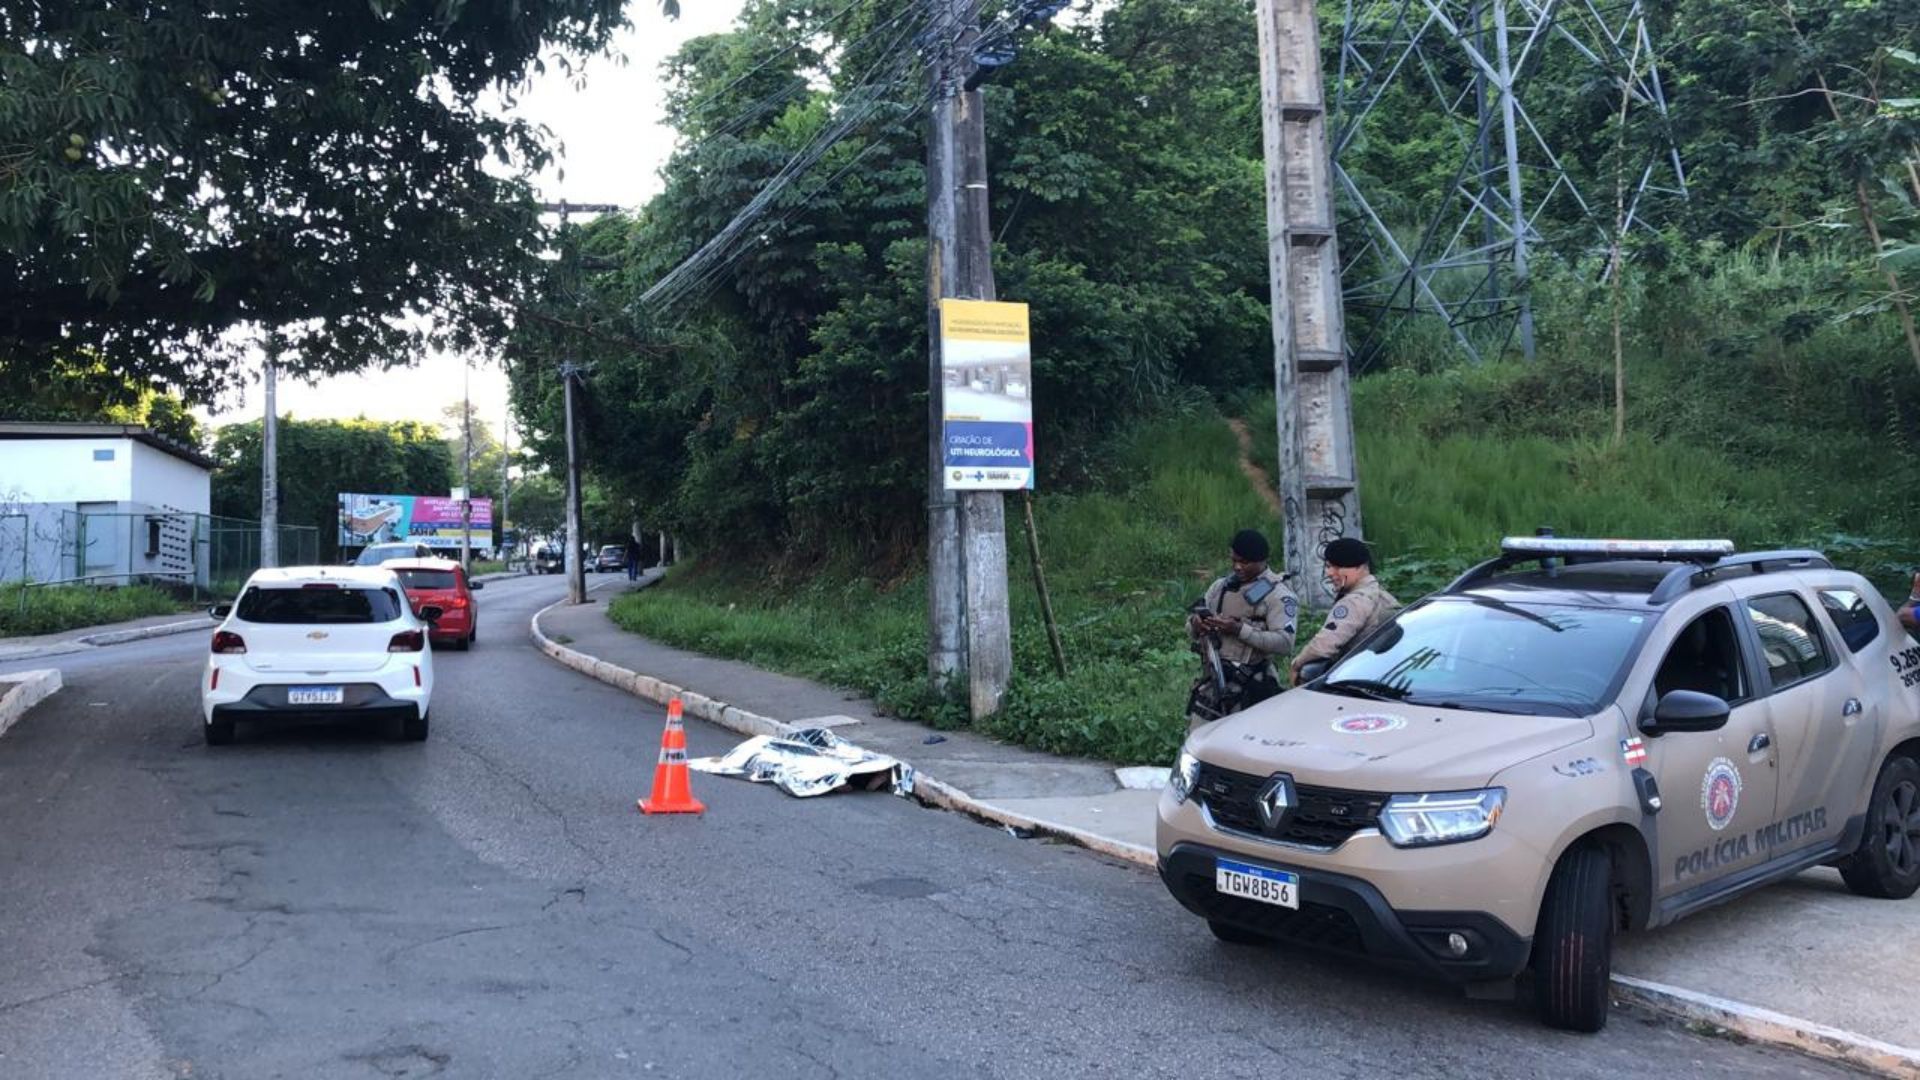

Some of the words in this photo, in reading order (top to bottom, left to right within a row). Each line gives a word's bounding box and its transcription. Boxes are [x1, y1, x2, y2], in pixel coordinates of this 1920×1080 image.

[982, 437, 993, 445] DE
[950, 448, 963, 456] UTI
[964, 447, 1021, 457] NEUROLÓGICA
[1674, 834, 1749, 880] POLÍCIA
[1755, 806, 1827, 850] MILITAR
[1223, 871, 1290, 903] TGW8B56
